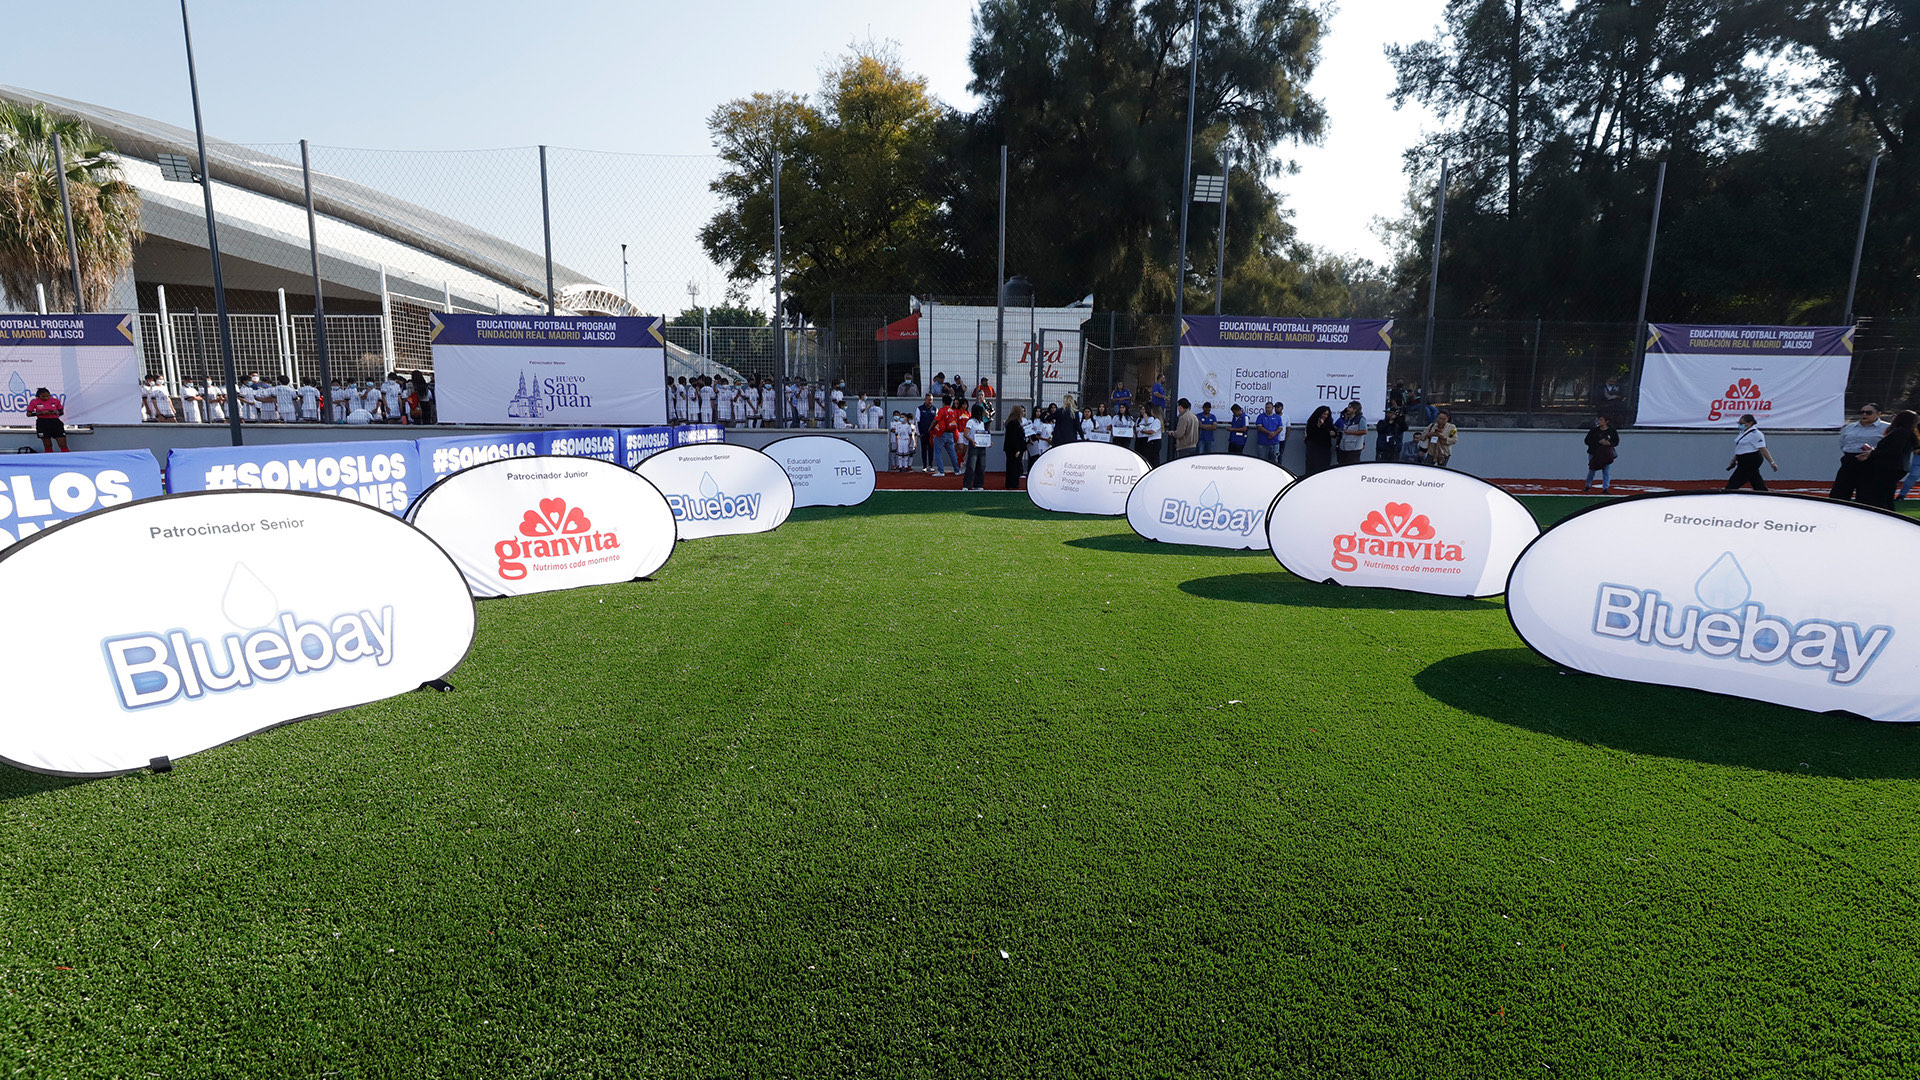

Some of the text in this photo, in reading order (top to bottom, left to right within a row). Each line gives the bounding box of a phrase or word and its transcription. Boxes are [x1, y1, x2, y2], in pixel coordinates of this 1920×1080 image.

[41, 320, 84, 329] PROGRAM
[476, 320, 616, 331] EDUCATIONAL FOOTBALL PROGRAM
[1219, 321, 1350, 334] EDUCATIONAL FOOTBALL PROGRAM
[11, 330, 46, 339] MADRID
[48, 330, 84, 339] JALISCO
[477, 329, 616, 341] FUNDACIÓN REAL MADRID JALISCO
[1219, 331, 1348, 343] FUNDACIÓN REAL MADRID JALISCO
[1689, 329, 1815, 340] EDUCATIONAL FOOTBALL PROGRAM
[1689, 339, 1813, 349] FUNDACIÓN REAL MADRID JALISCO
[1235, 368, 1289, 379] Educational
[544, 378, 578, 395] San
[1234, 381, 1271, 391] Football
[1316, 385, 1361, 400] TRUE
[546, 394, 592, 412] Juan
[1234, 393, 1273, 404] Program
[1708, 398, 1772, 421] granvita
[551, 436, 615, 455] #SOMOSLOS
[626, 432, 669, 450] #SOMOSLOS
[433, 442, 535, 473] #SOMOSLOS
[205, 452, 407, 490] #SOMOSLOS
[834, 466, 862, 476] TRUE
[1063, 462, 1096, 470] Educational
[507, 470, 588, 480] Patrocinador Junior
[1061, 477, 1085, 485] Program
[1108, 475, 1138, 485] TRUE
[1361, 475, 1445, 488] Patrocinador Junior
[667, 492, 761, 521] Bluebay
[1160, 498, 1264, 536] Bluebay
[1663, 513, 1817, 533] Patrocinador Senior
[150, 517, 305, 539] Patrocinador Senior
[494, 530, 621, 580] granvita
[1331, 531, 1465, 572] granvita
[533, 555, 620, 571] Nutrimos cada momento
[1363, 560, 1399, 571] Nutrimos
[1422, 566, 1461, 574] momento
[1593, 583, 1894, 685] Bluebay
[103, 604, 394, 710] Bluebay
